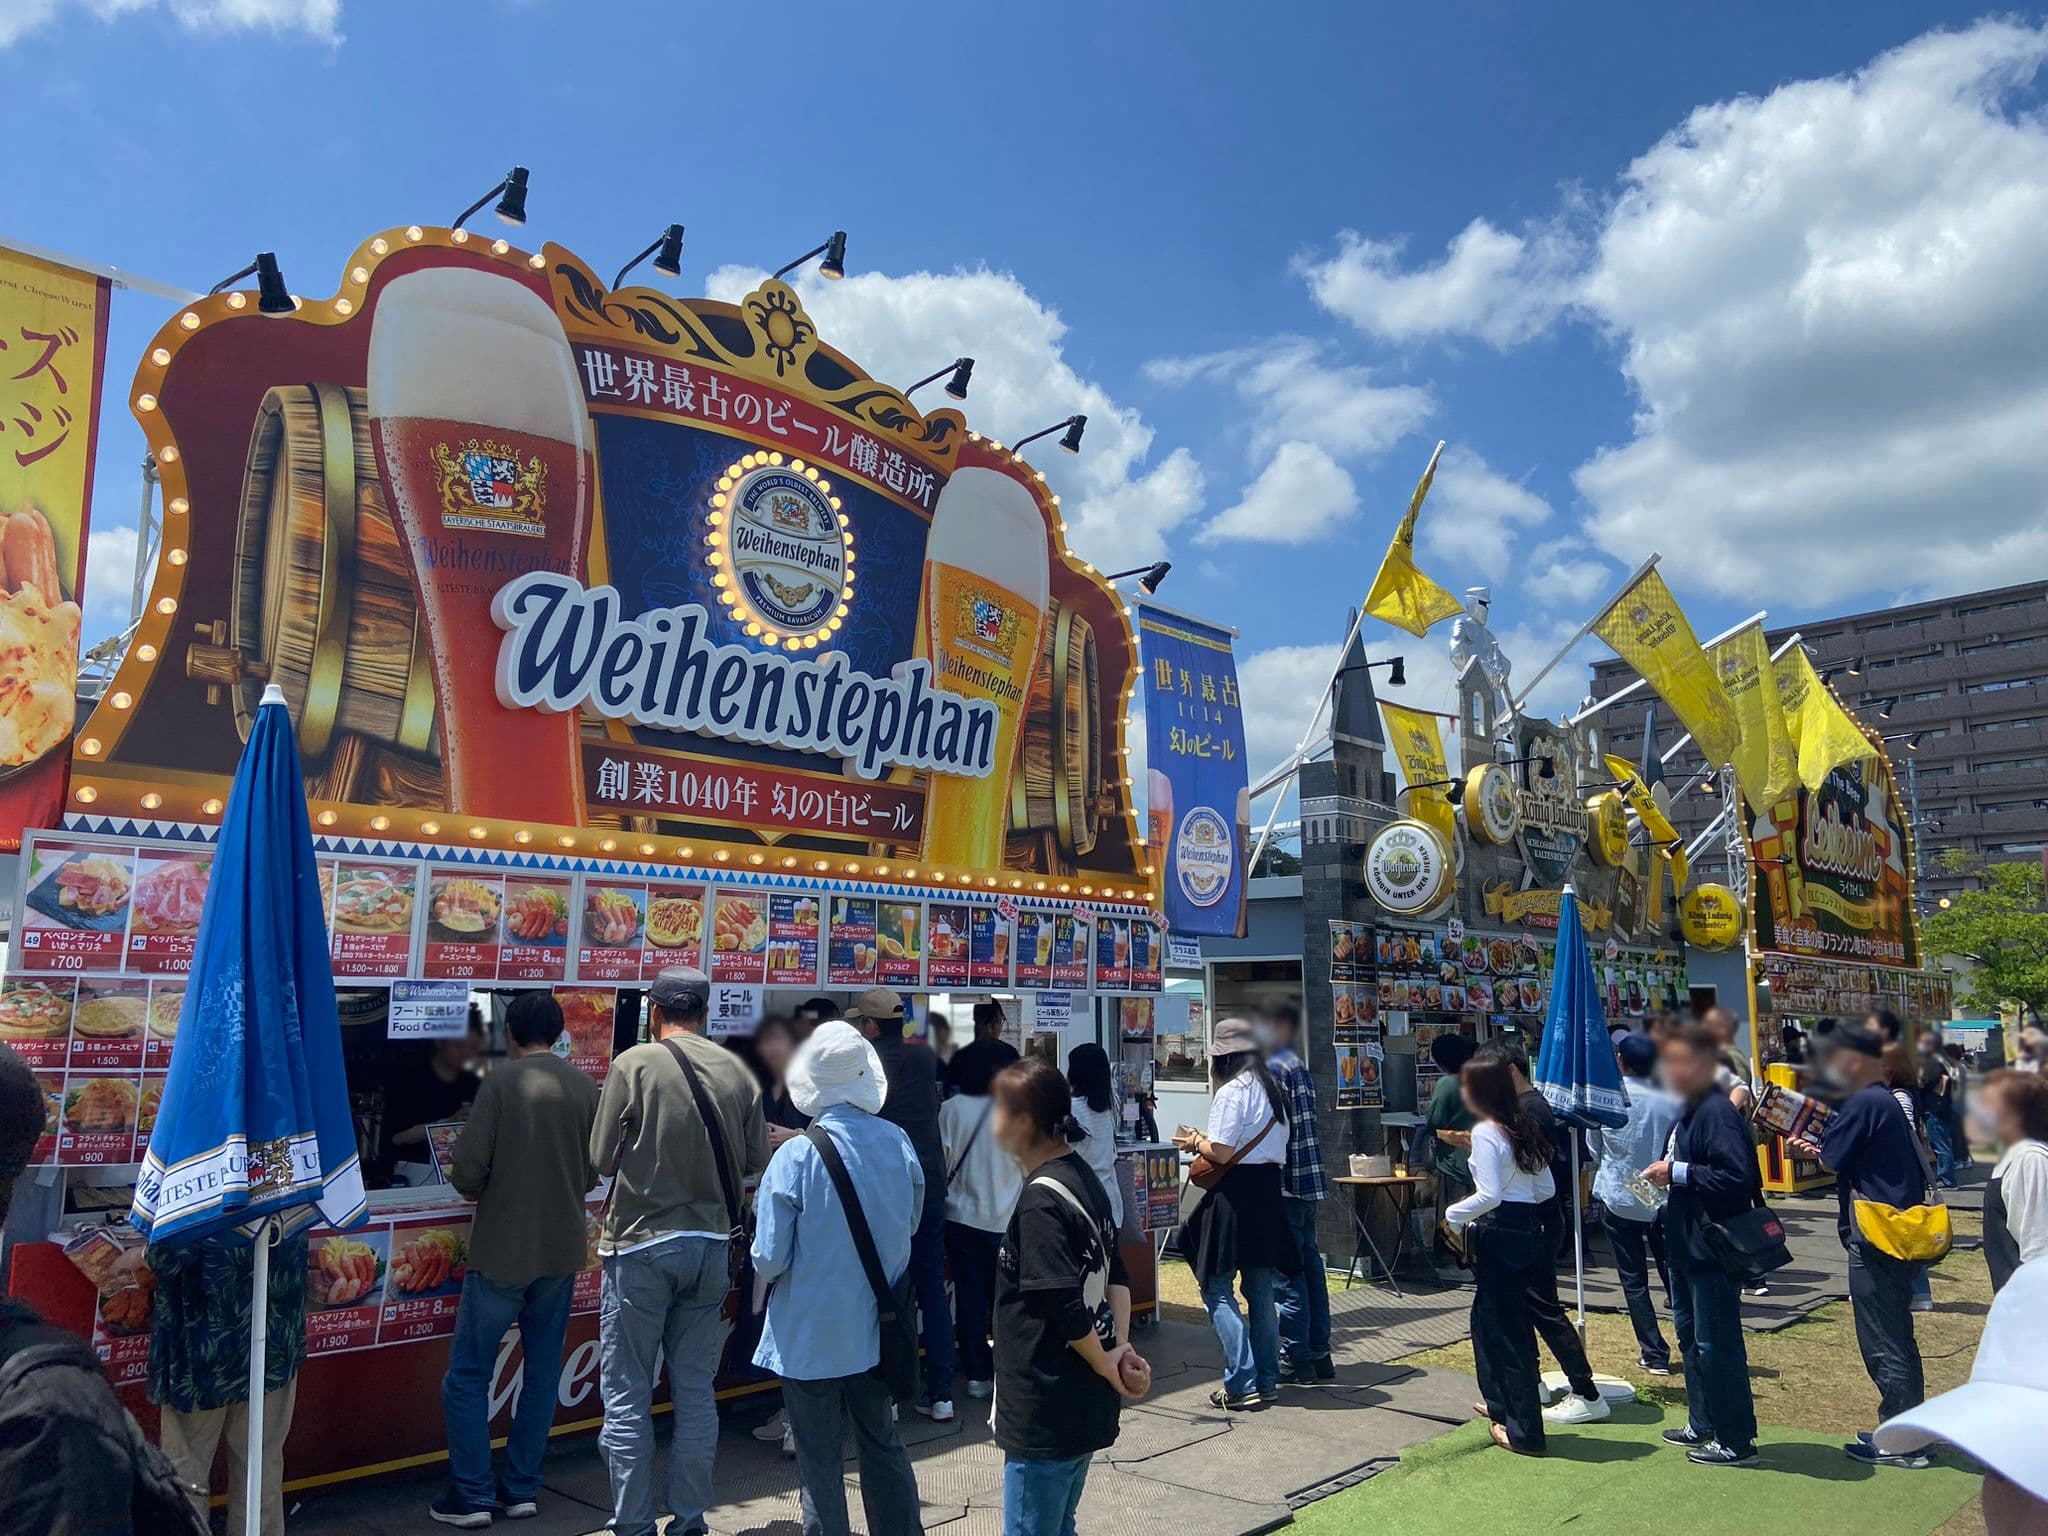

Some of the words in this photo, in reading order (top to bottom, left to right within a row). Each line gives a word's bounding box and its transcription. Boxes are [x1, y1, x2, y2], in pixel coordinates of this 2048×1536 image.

[582, 349, 935, 508] 世界最古のビール醸造所
[785, 478, 809, 495] OLDEST
[442, 514, 486, 528] BAYERISCHE
[736, 526, 840, 573] Weihenstephan
[755, 594, 786, 623] PREMIUM
[787, 607, 823, 625] BAVARICUM
[512, 583, 997, 770] Weihenstephan
[938, 647, 1023, 704] Weihenstephan
[1154, 656, 1239, 708] 世界最古
[1169, 725, 1237, 761] 幻のビール
[596, 757, 760, 818] 創業1040年
[770, 787, 916, 833] 幻の白ビール
[1520, 795, 1551, 831] König
[1552, 801, 1589, 839] Ludwig
[1179, 845, 1230, 865] Weihenstephan
[1373, 866, 1392, 896] KÖNIGIN
[1392, 889, 1417, 900] UNTER
[1416, 876, 1429, 892] DEN
[26, 936, 39, 945] 49
[51, 942, 102, 952] いかのマリネ
[132, 938, 146, 947] 47
[150, 935, 196, 944] ペッパーポー
[51, 955, 84, 969] ¥700
[502, 951, 512, 960] 30
[720, 988, 753, 1003] ビール
[393, 1005, 466, 1016] フード販売レジ
[718, 1003, 753, 1018] 受取口
[392, 1021, 420, 1032] Food
[711, 1022, 728, 1031] Pick
[311, 1311, 359, 1323] スペアリブ入り
[384, 1309, 396, 1319] 30
[402, 1310, 428, 1319] ソーセージ
